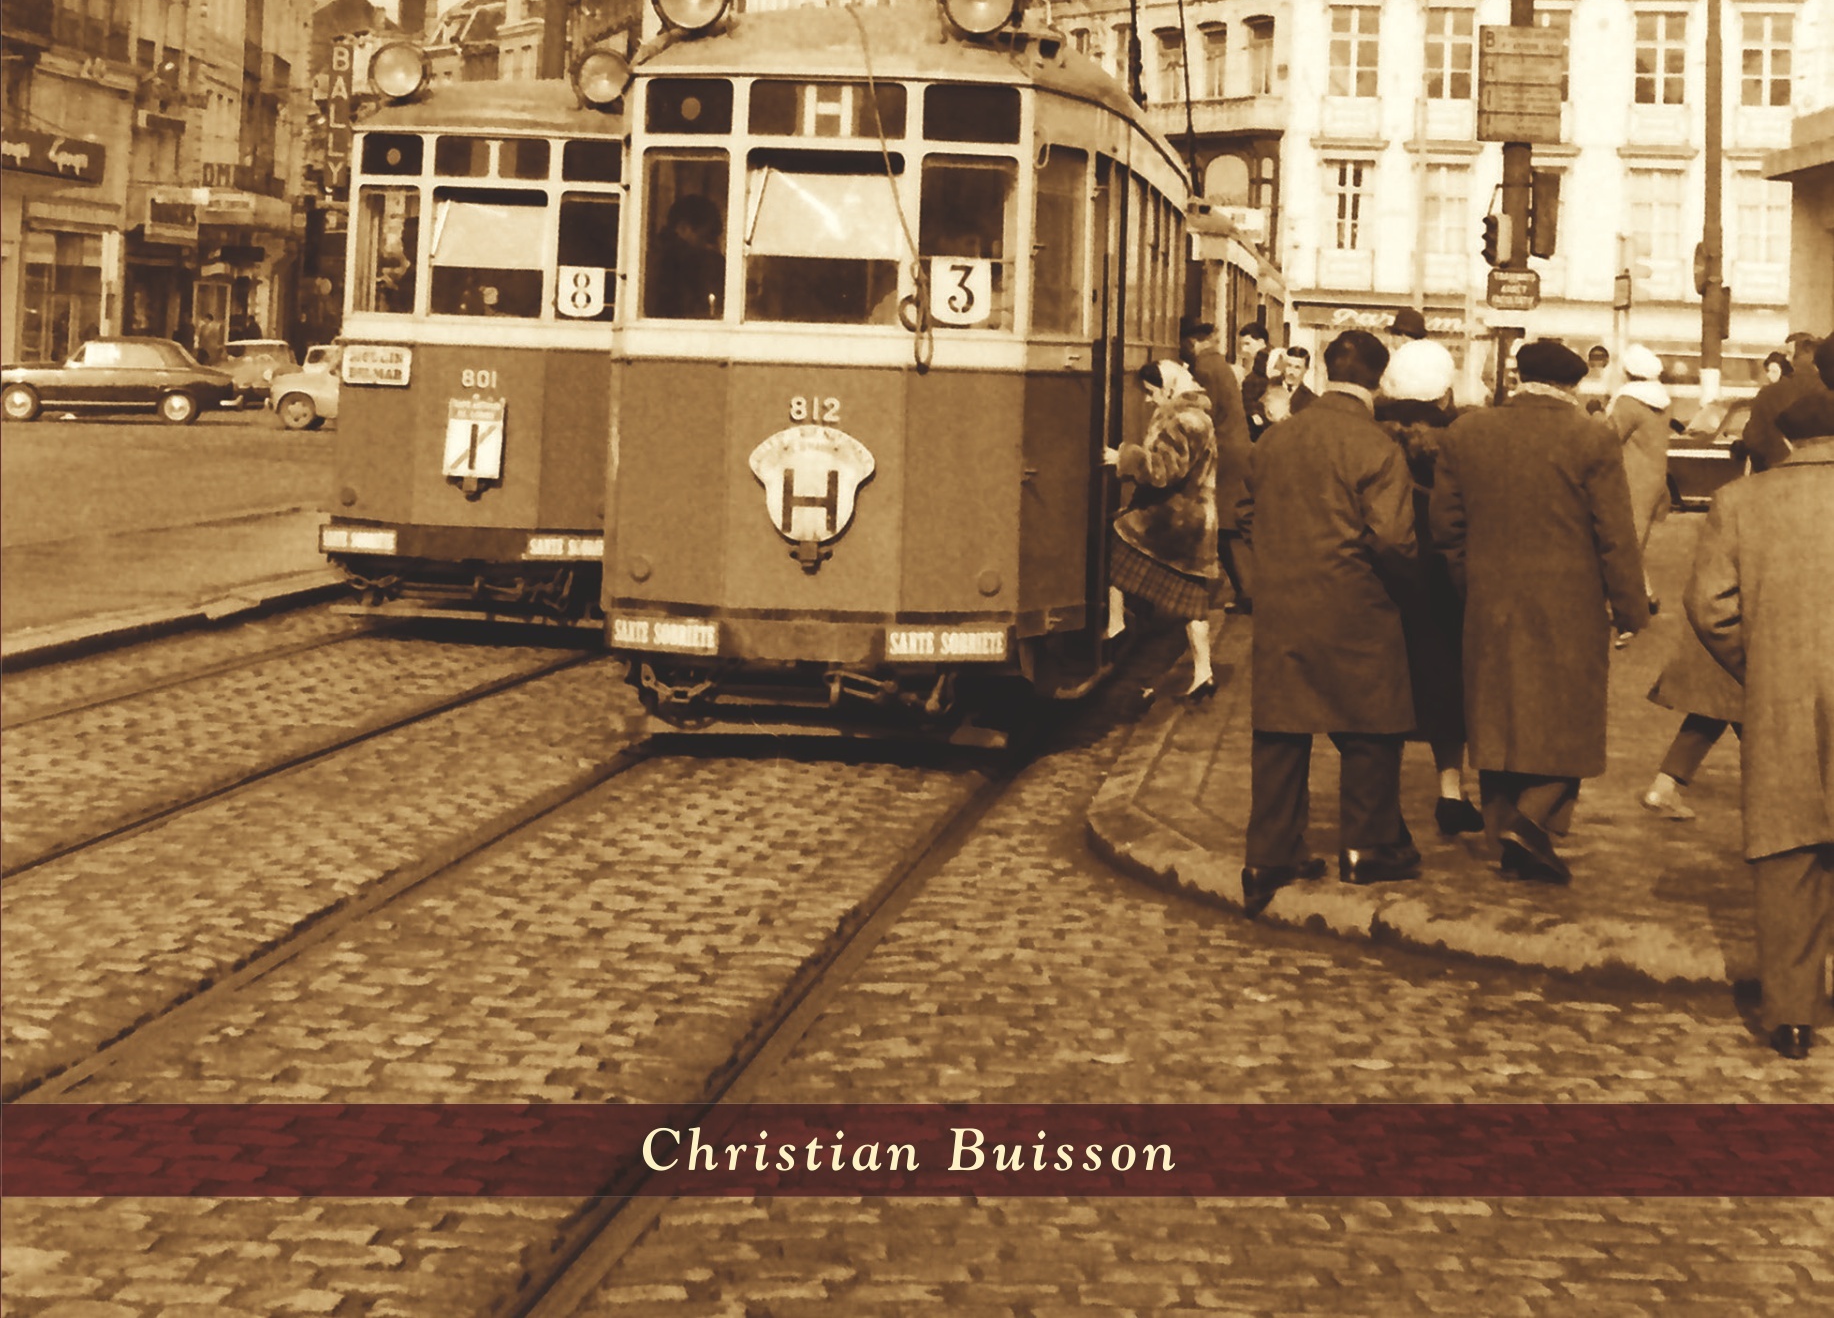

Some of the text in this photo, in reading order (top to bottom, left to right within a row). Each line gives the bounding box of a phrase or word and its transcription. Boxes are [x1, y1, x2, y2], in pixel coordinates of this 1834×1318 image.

[328, 46, 350, 184] BALLY
[803, 85, 853, 138] H
[571, 272, 592, 309] 8
[948, 264, 975, 313] 3
[461, 369, 497, 388] 801
[790, 396, 841, 422] 812
[782, 468, 839, 533] H
